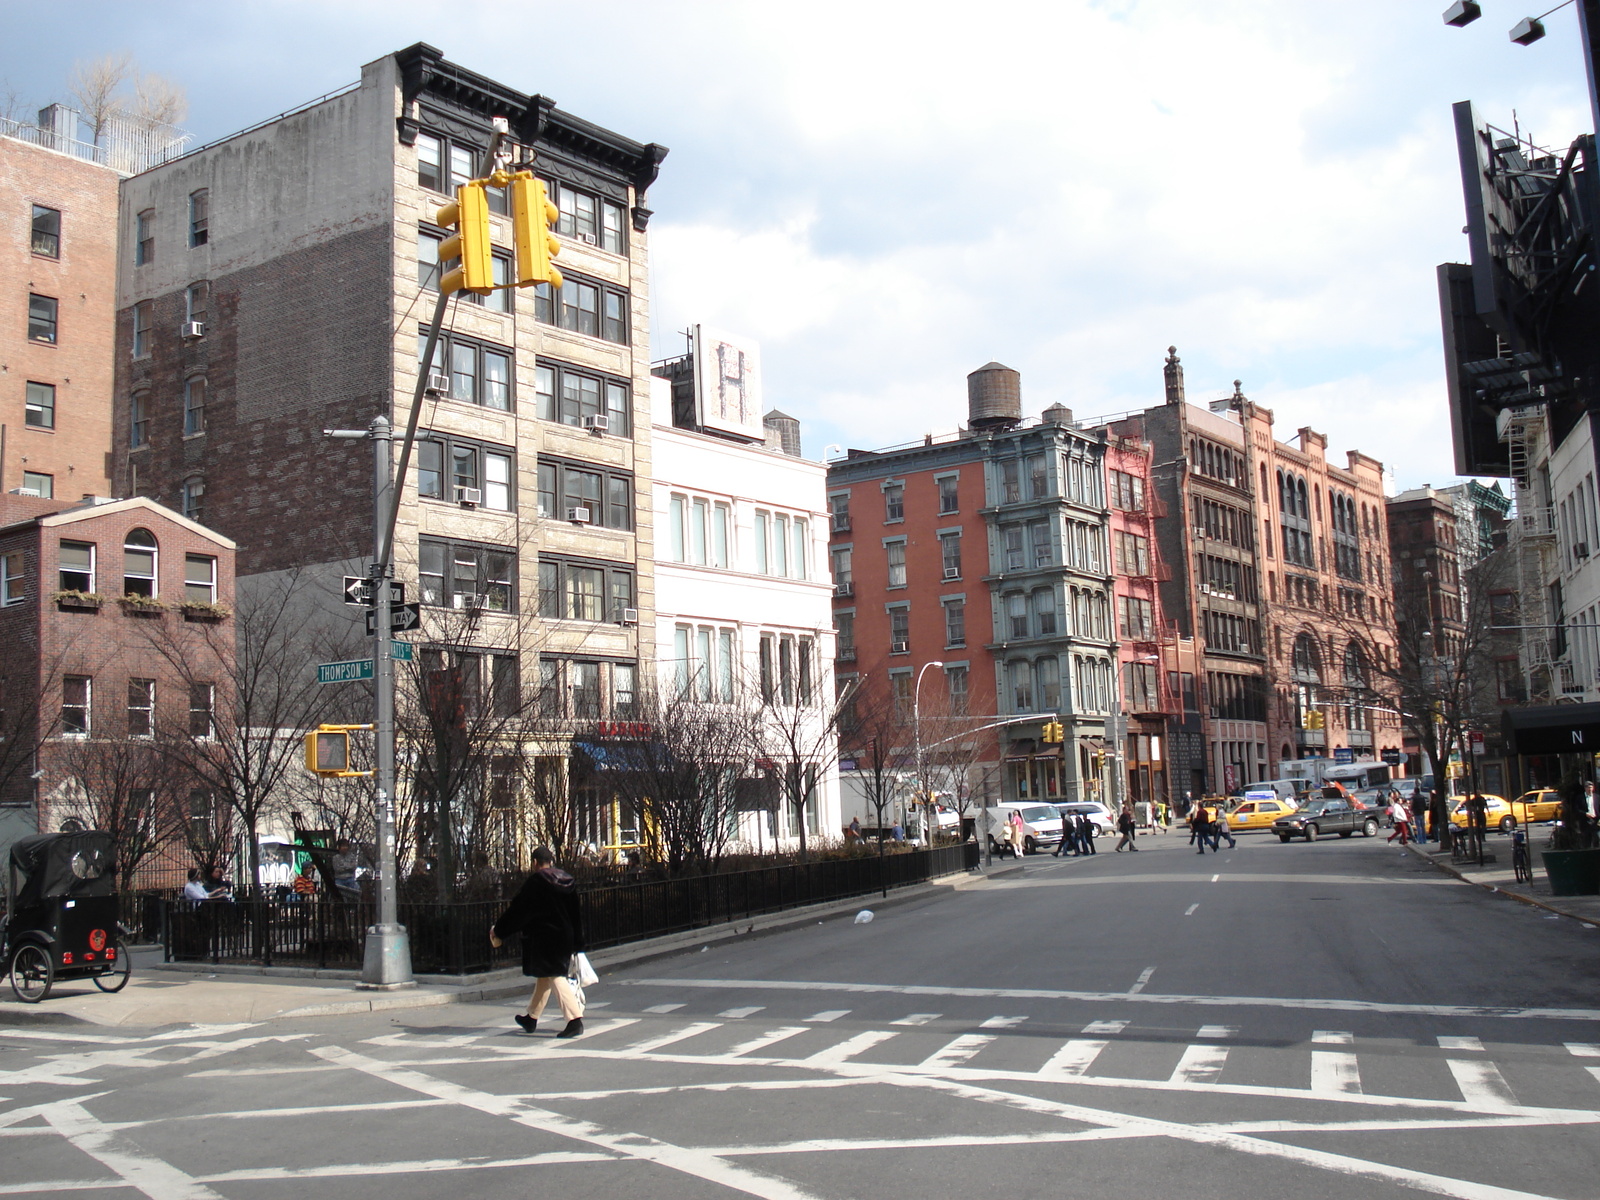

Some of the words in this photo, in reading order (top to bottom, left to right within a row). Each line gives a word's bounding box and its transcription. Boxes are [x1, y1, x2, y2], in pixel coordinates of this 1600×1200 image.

[353, 586, 370, 597] ONE
[395, 612, 412, 624] WAY
[320, 662, 361, 681] THOMPSON
[363, 661, 372, 670] ST
[1571, 730, 1583, 744] N
